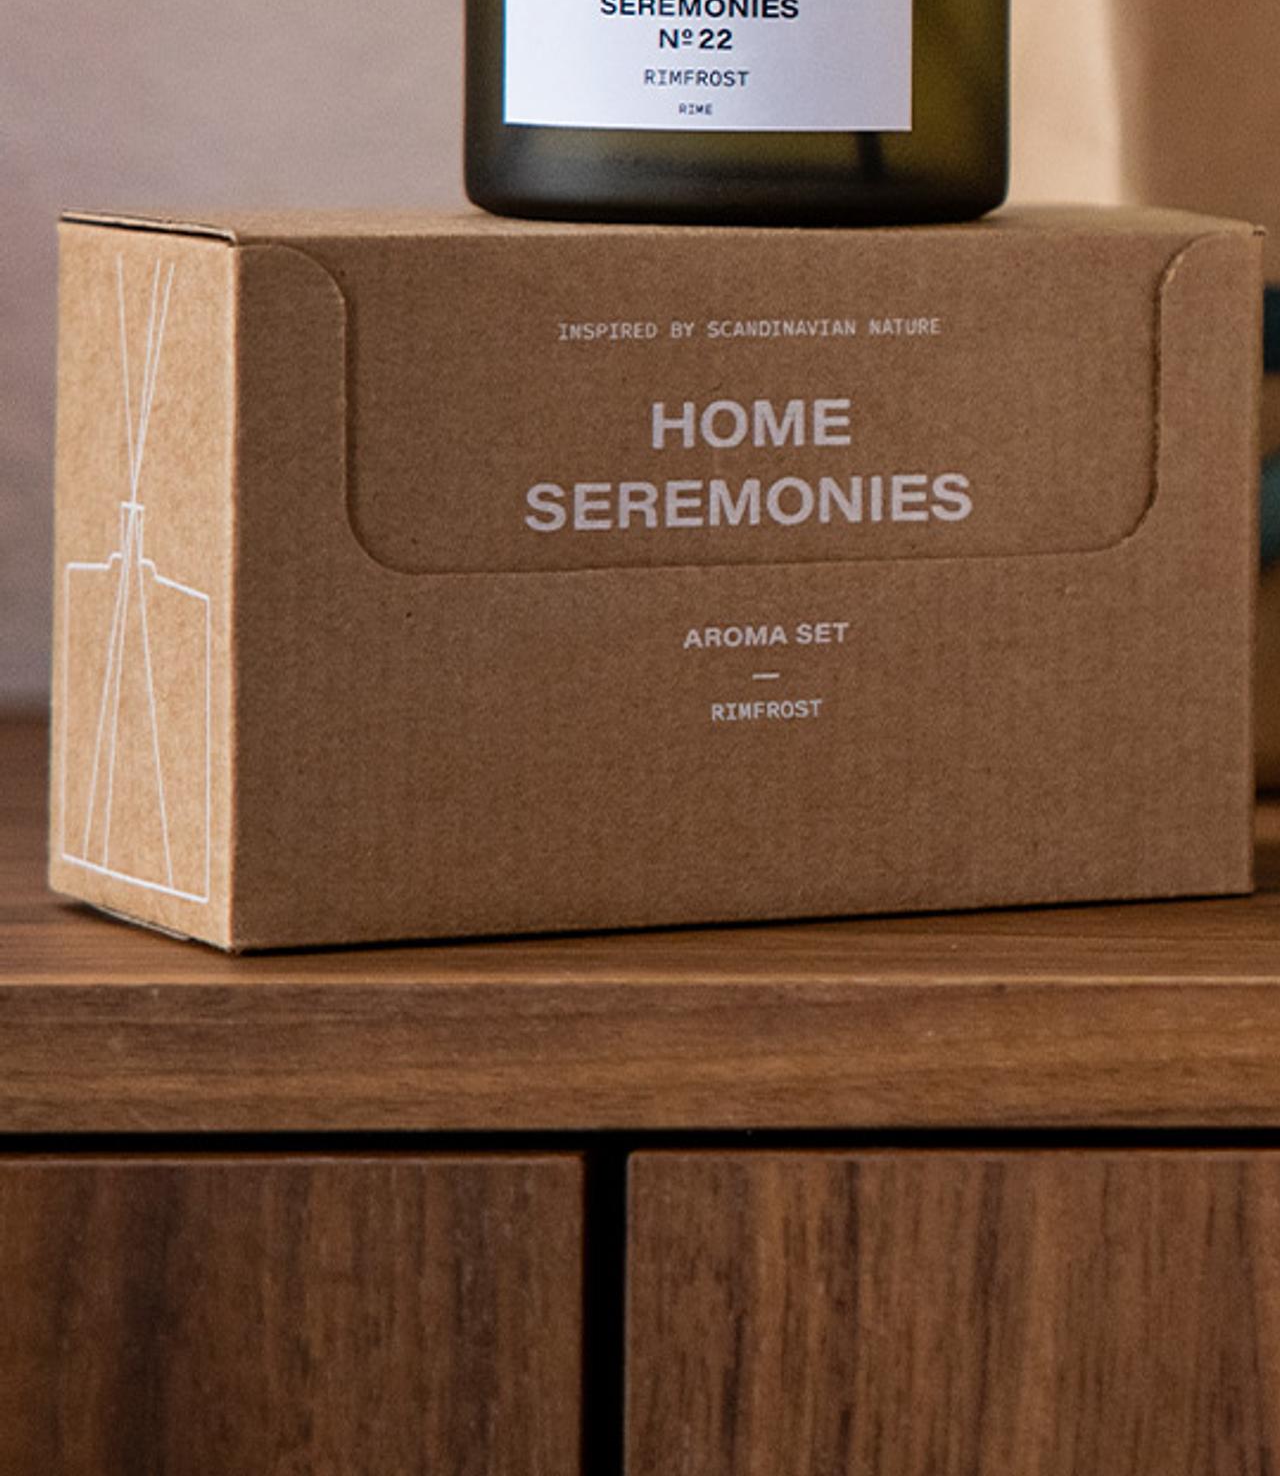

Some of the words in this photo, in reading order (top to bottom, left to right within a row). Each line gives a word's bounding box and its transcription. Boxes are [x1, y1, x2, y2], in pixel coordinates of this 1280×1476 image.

[644, 69, 749, 86] RIMFROST
[679, 103, 712, 115] RIME
[559, 322, 657, 341] INSPIRED
[672, 322, 694, 338] BY
[707, 320, 856, 338] SCANDINAVIAN
[869, 319, 941, 335] NATURE
[651, 399, 851, 449] HOME
[525, 474, 973, 532] SEREMONIES
[683, 625, 787, 649] AROMA
[796, 623, 849, 644] SET
[711, 700, 822, 721] RIMFROST
